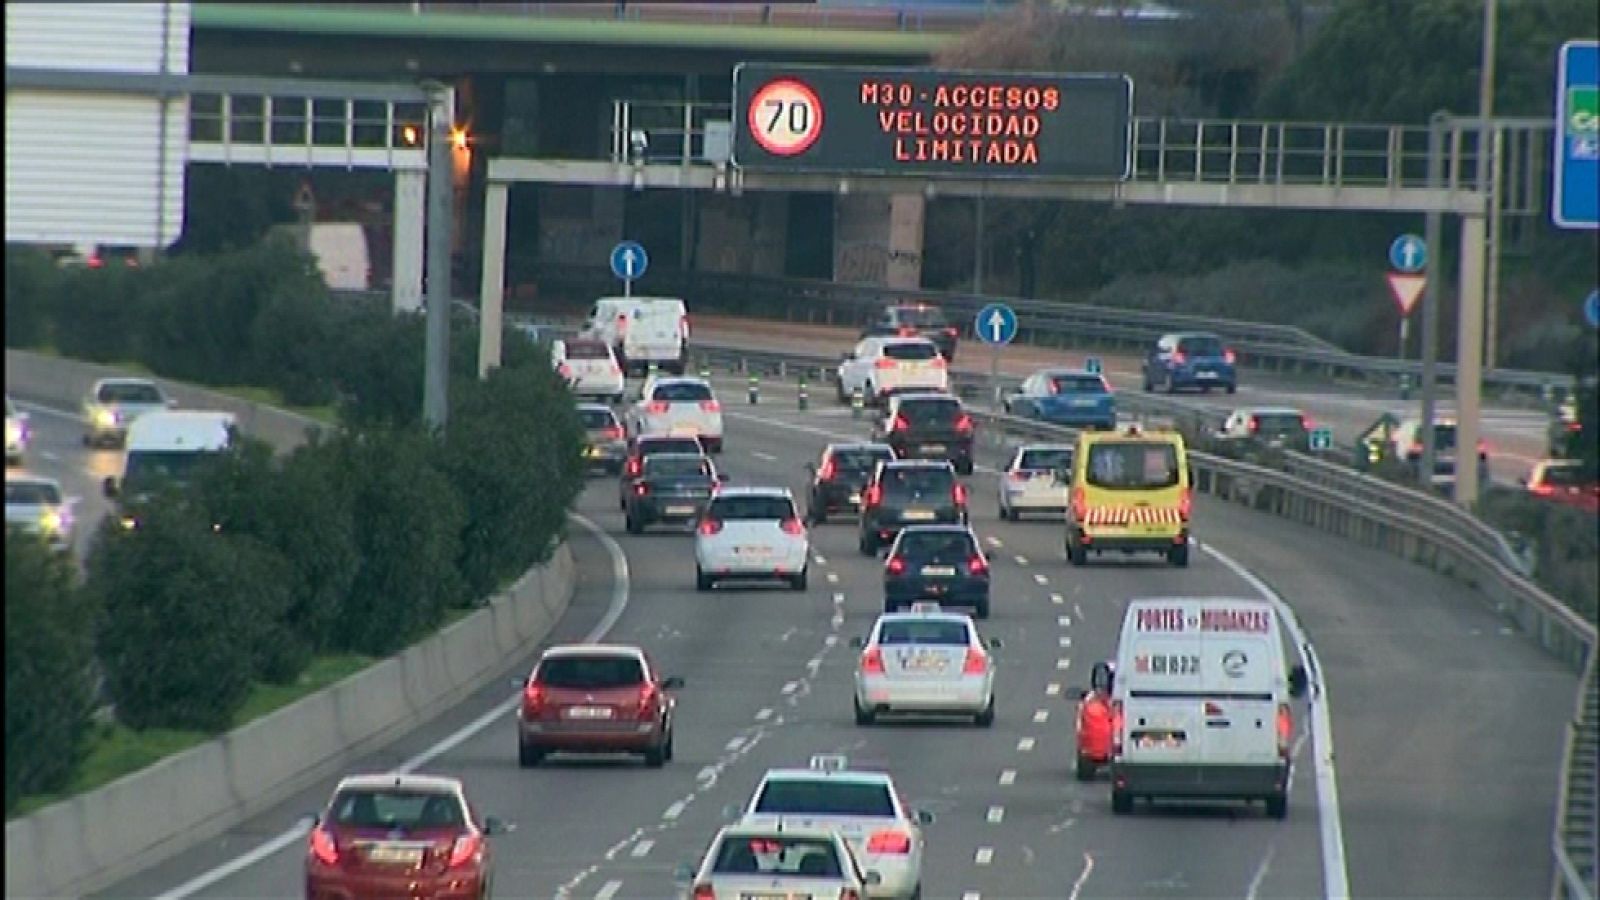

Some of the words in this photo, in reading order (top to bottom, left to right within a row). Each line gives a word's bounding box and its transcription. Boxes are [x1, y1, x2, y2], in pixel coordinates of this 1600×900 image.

[763, 98, 810, 135] 70
[879, 111, 1041, 136] VELOCIDAD
[895, 140, 1038, 164] LIMITADA
[1137, 608, 1184, 633] PORTES
[1201, 608, 1271, 634] MUDANZAS
